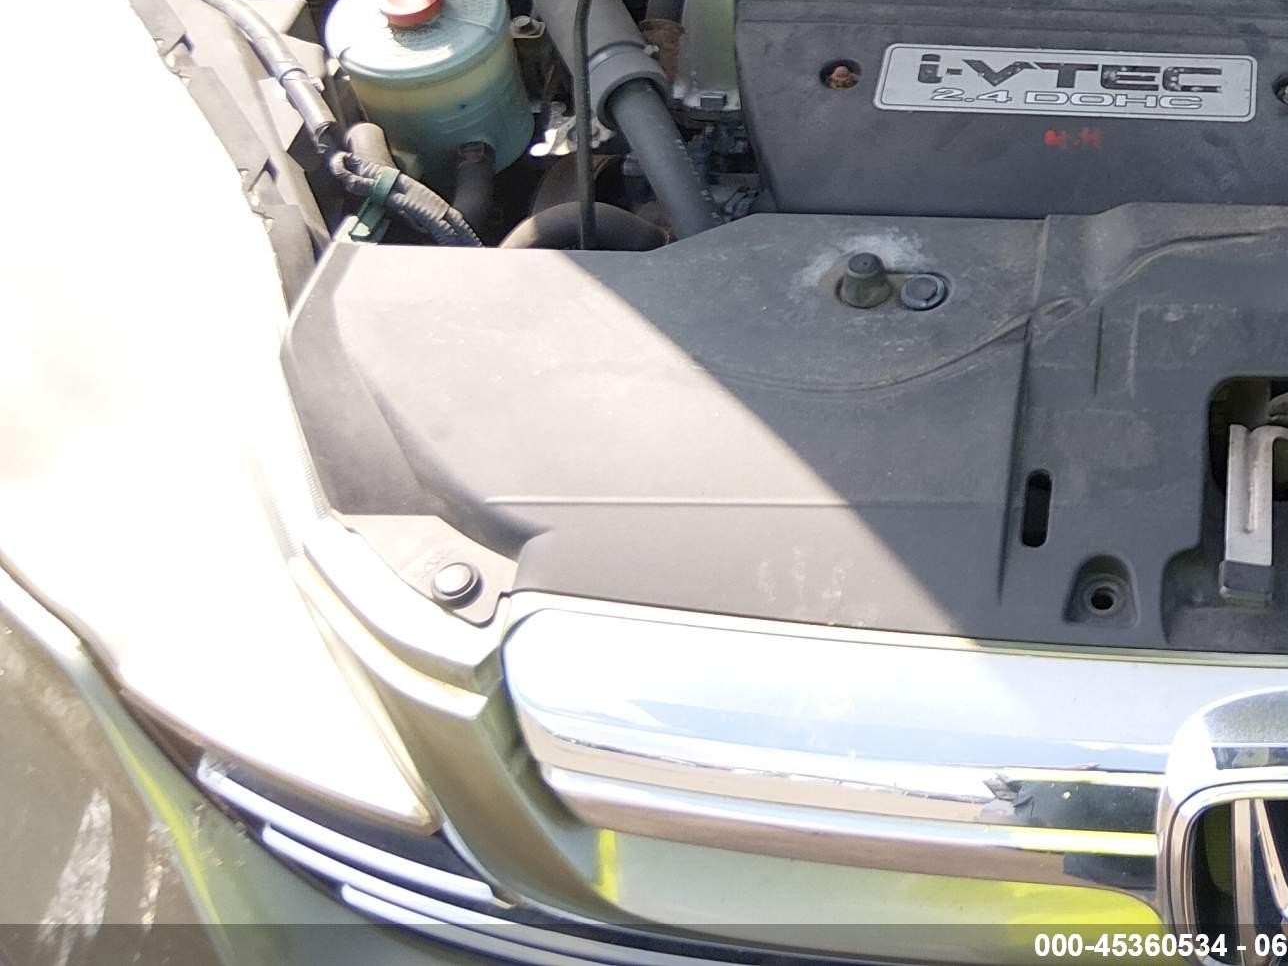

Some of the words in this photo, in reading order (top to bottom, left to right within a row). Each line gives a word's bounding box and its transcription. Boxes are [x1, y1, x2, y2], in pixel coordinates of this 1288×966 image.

[917, 53, 1223, 93] i-VTEC
[931, 88, 1012, 103] 2.4
[1023, 90, 1204, 110] DOHC
